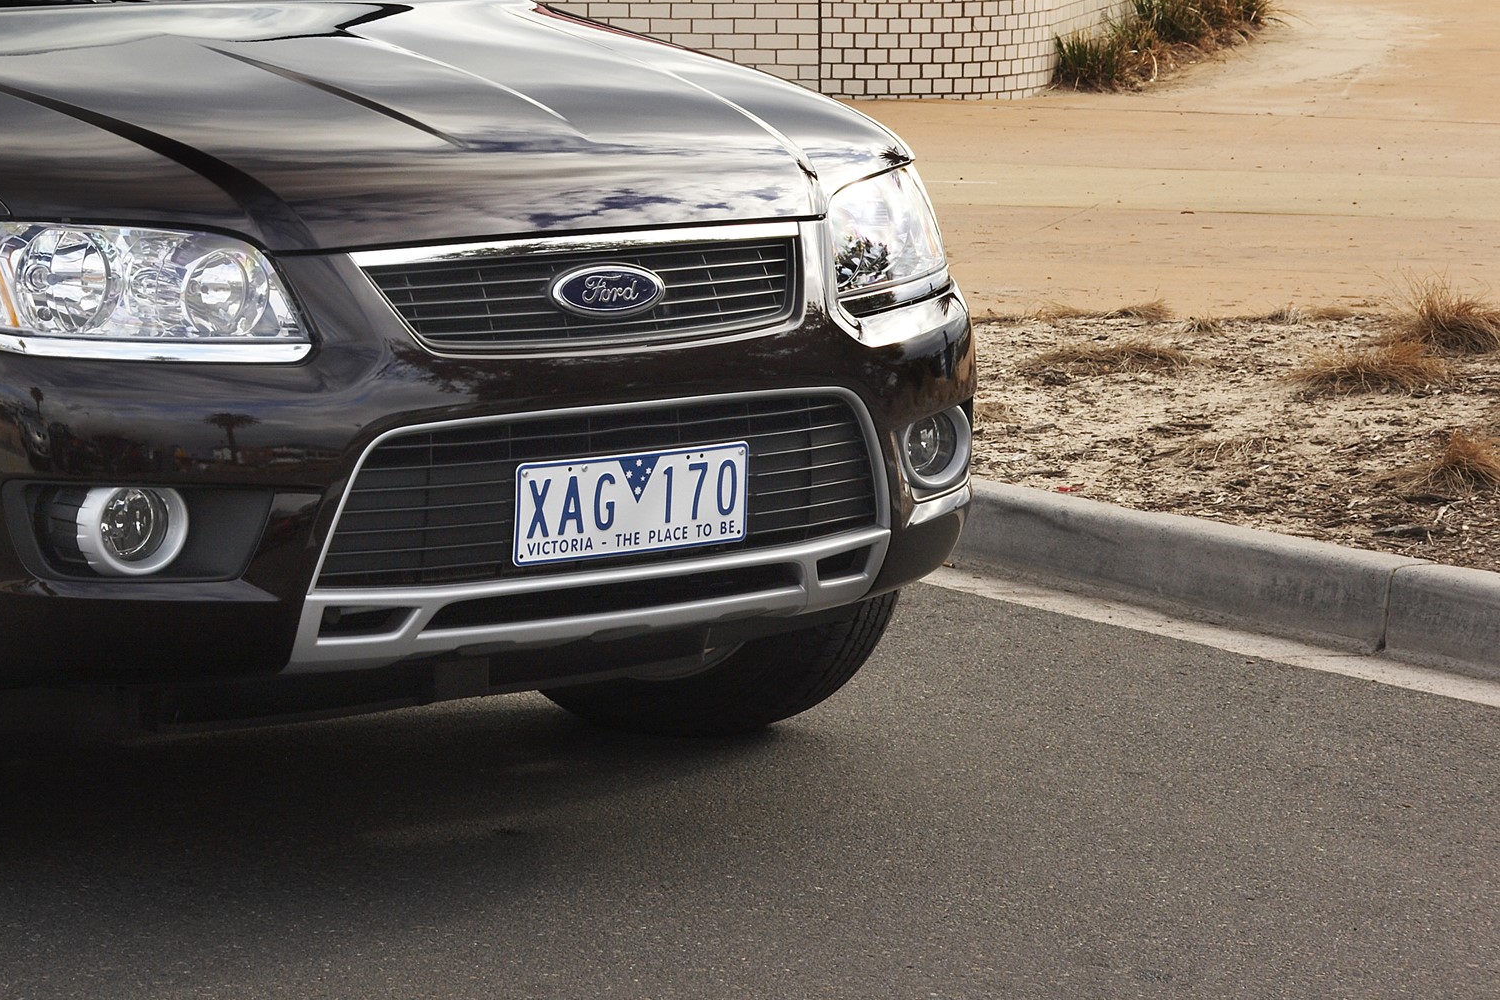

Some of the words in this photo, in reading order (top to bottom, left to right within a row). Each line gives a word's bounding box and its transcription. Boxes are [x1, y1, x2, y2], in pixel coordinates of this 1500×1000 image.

[581, 275, 639, 304] Ford
[526, 473, 616, 539] XAG
[663, 459, 738, 524] 170
[527, 536, 594, 556] VICTORIA
[615, 531, 640, 547] THE
[648, 525, 688, 543] PLACE
[696, 522, 712, 537] TO
[720, 519, 735, 535] BE
